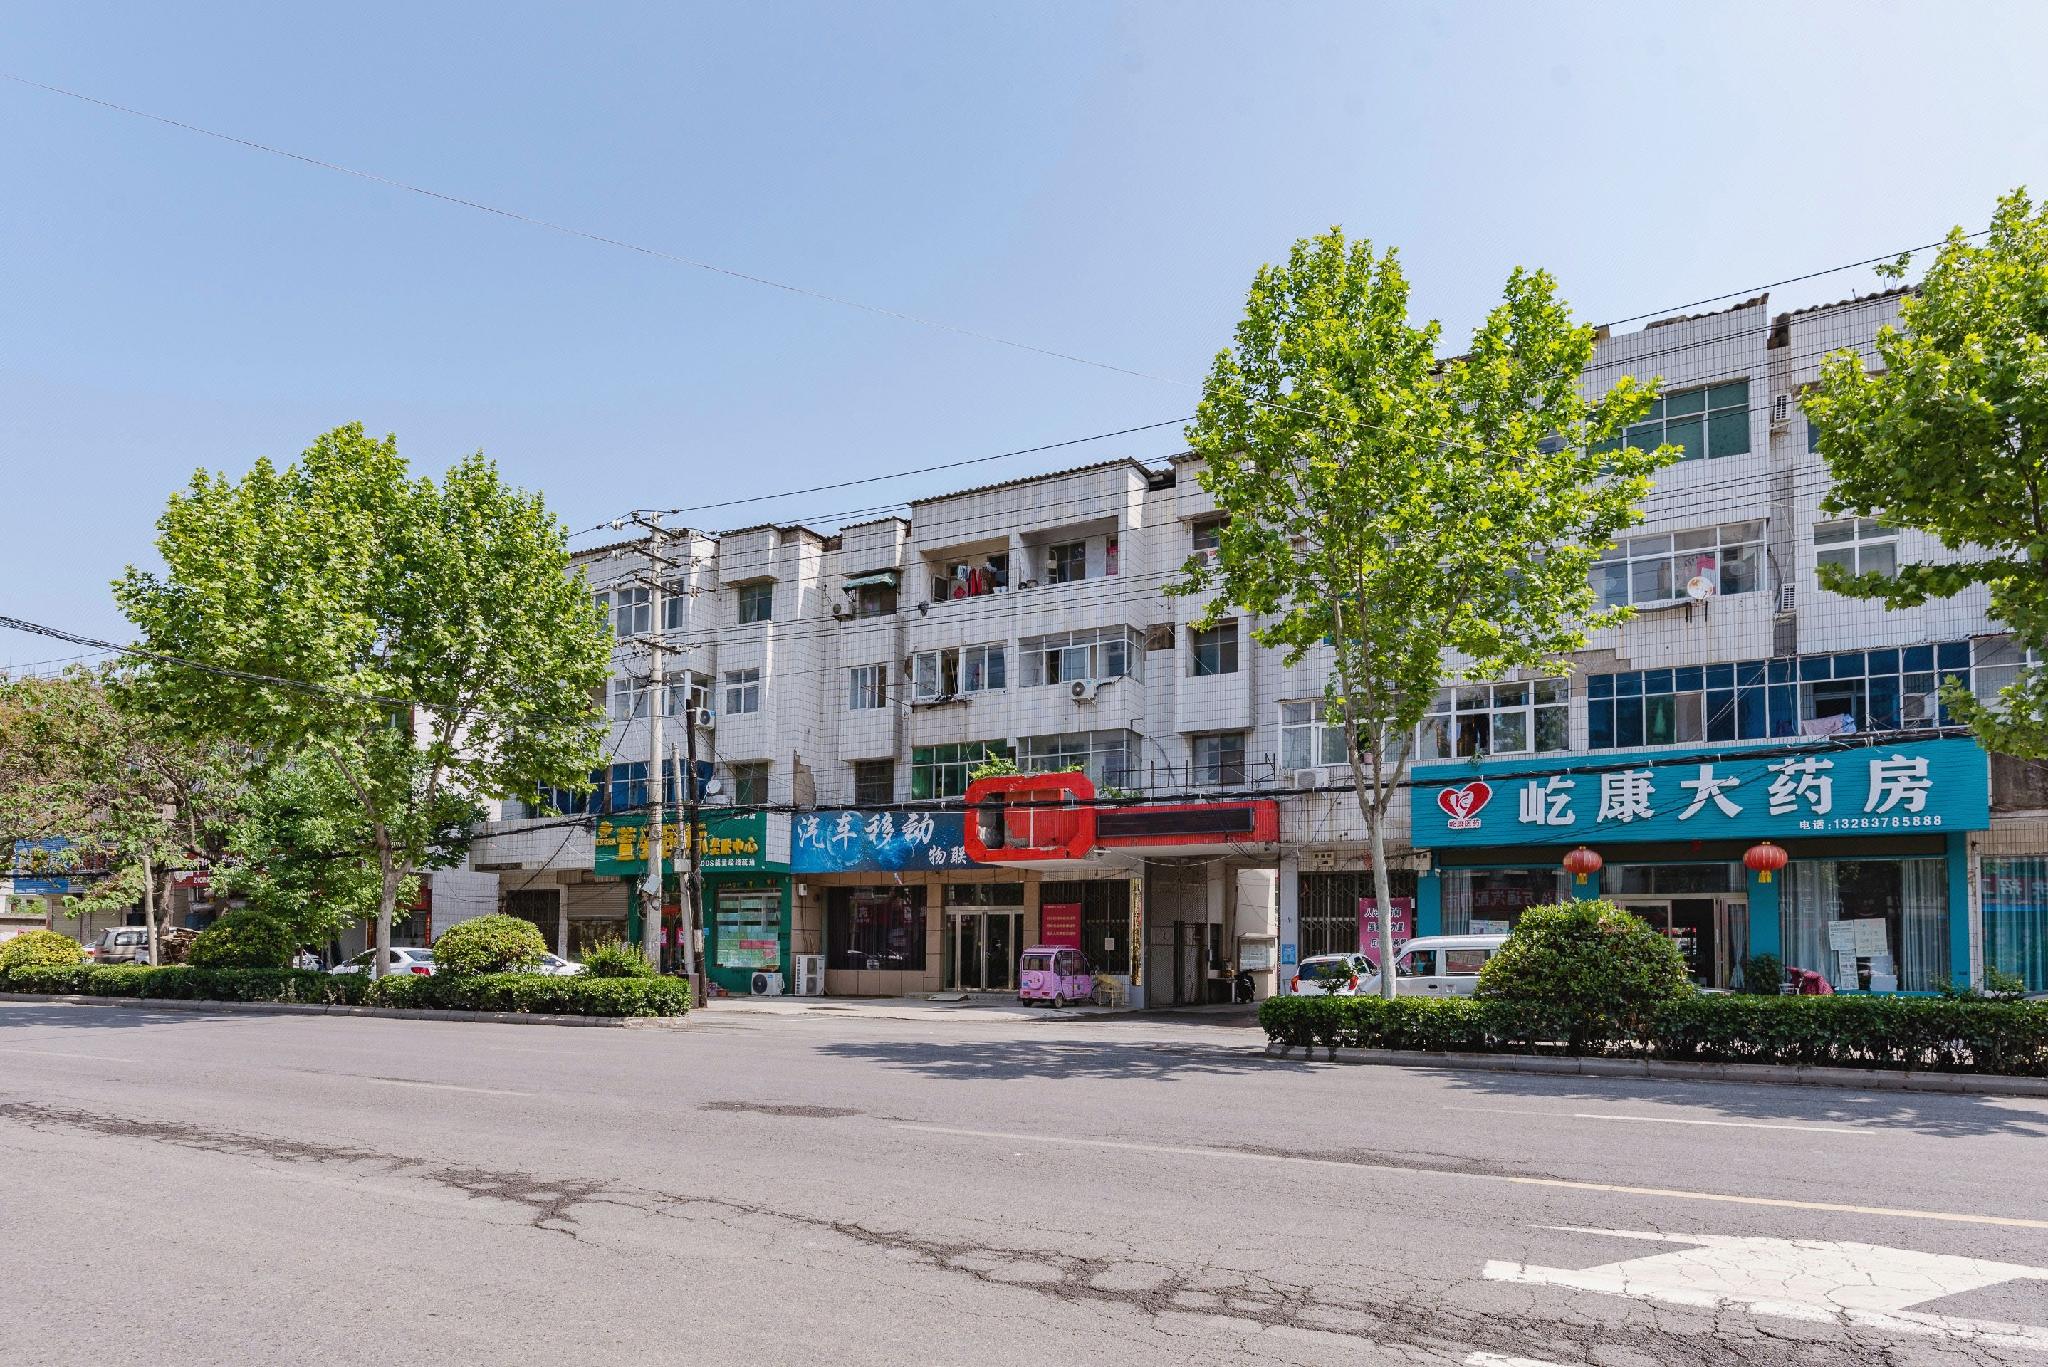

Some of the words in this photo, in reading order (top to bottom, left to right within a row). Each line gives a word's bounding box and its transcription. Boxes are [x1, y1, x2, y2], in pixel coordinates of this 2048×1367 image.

[1518, 754, 1935, 826] 屹康大药房
[797, 811, 935, 851] 汽车移动
[928, 845, 967, 865] 物联
